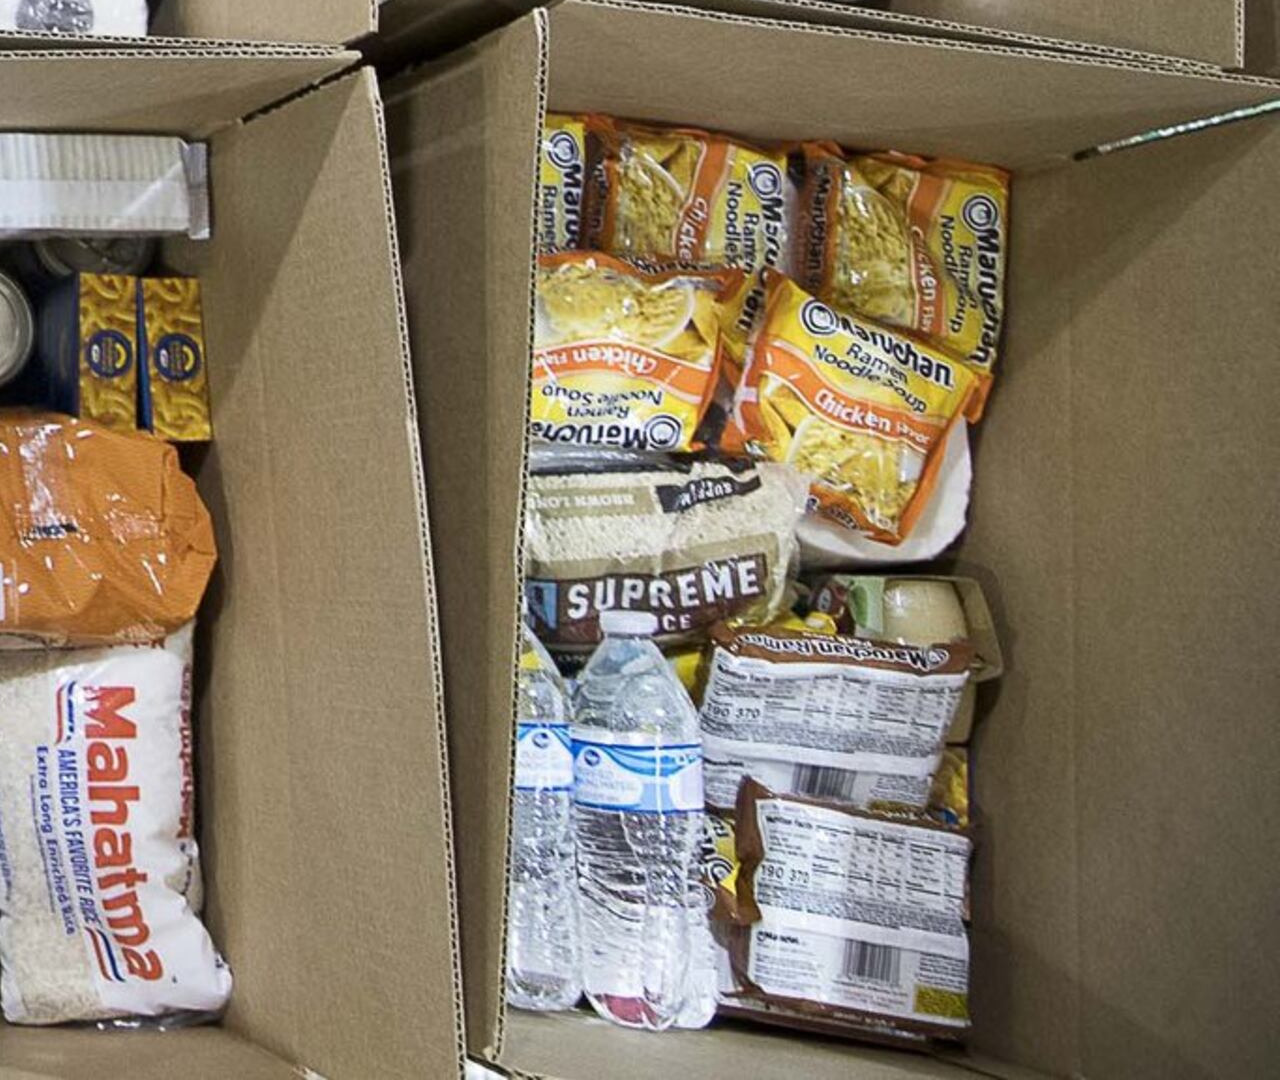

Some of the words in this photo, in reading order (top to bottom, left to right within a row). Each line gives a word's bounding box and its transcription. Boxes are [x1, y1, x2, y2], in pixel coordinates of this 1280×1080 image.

[571, 347, 658, 375] Chicken
[839, 315, 952, 388] Maruchan
[847, 343, 909, 385] Ramen
[814, 344, 881, 383] Noodle
[880, 378, 928, 413] Soup
[567, 405, 631, 419] Ramen
[814, 389, 891, 432] Chicken
[573, 493, 635, 507] BROWN
[567, 559, 759, 621] SUPREME
[819, 643, 929, 670] Maruchan
[36, 746, 50, 791] Extra
[58, 749, 82, 828] AMERICA'S
[40, 794, 54, 834] Long
[84, 685, 164, 983] Mahatma
[45, 838, 67, 903] Enriched
[67, 829, 94, 897] FAVORITE
[761, 864, 785, 879] 190
[789, 868, 811, 885] 370
[78, 896, 101, 929] RICE
